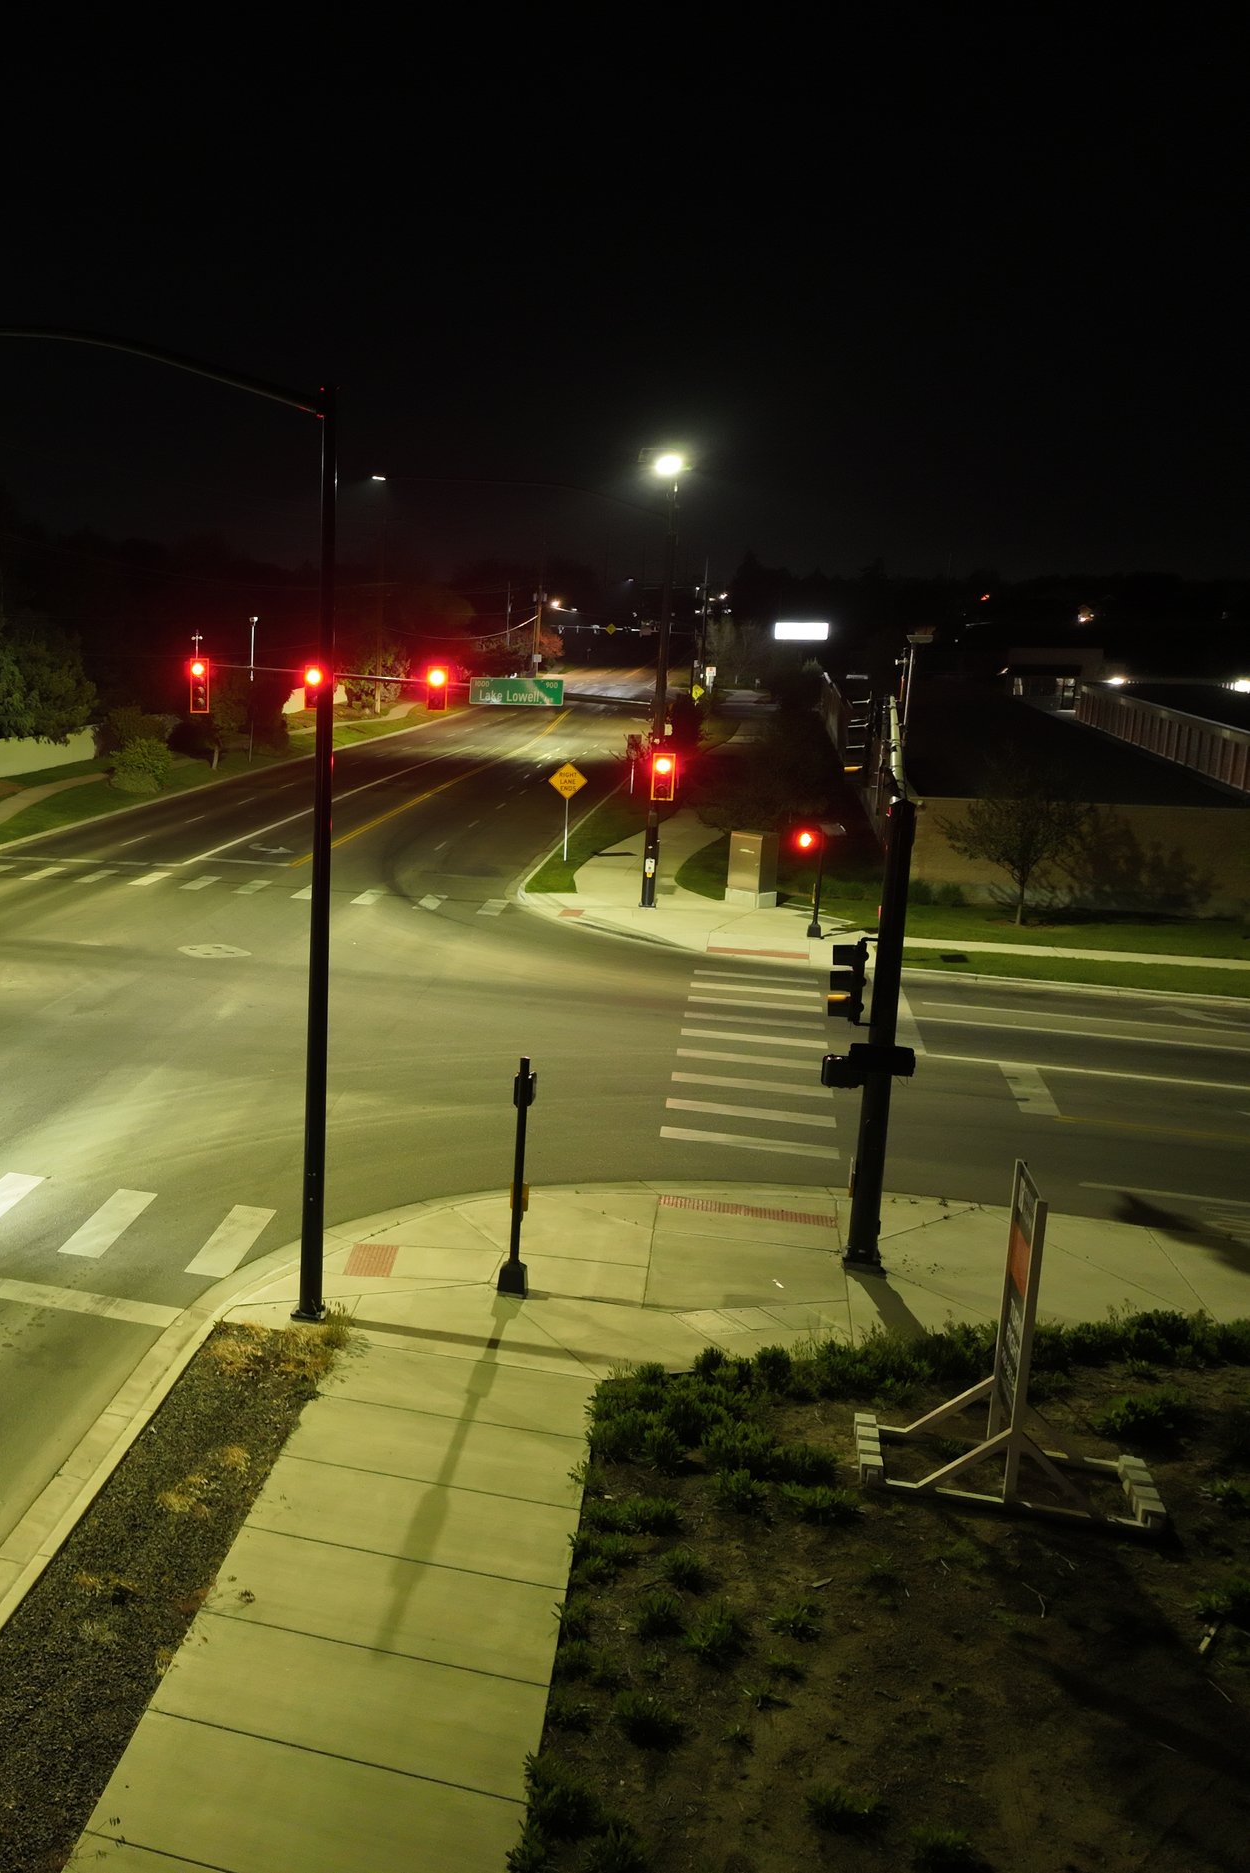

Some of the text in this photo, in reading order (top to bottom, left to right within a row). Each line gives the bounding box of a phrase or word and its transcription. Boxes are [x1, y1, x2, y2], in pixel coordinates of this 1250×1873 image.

[474, 680, 490, 688] 1000
[545, 681, 559, 689] 900
[479, 689, 502, 702] Lake
[506, 689, 539, 703] Lowell
